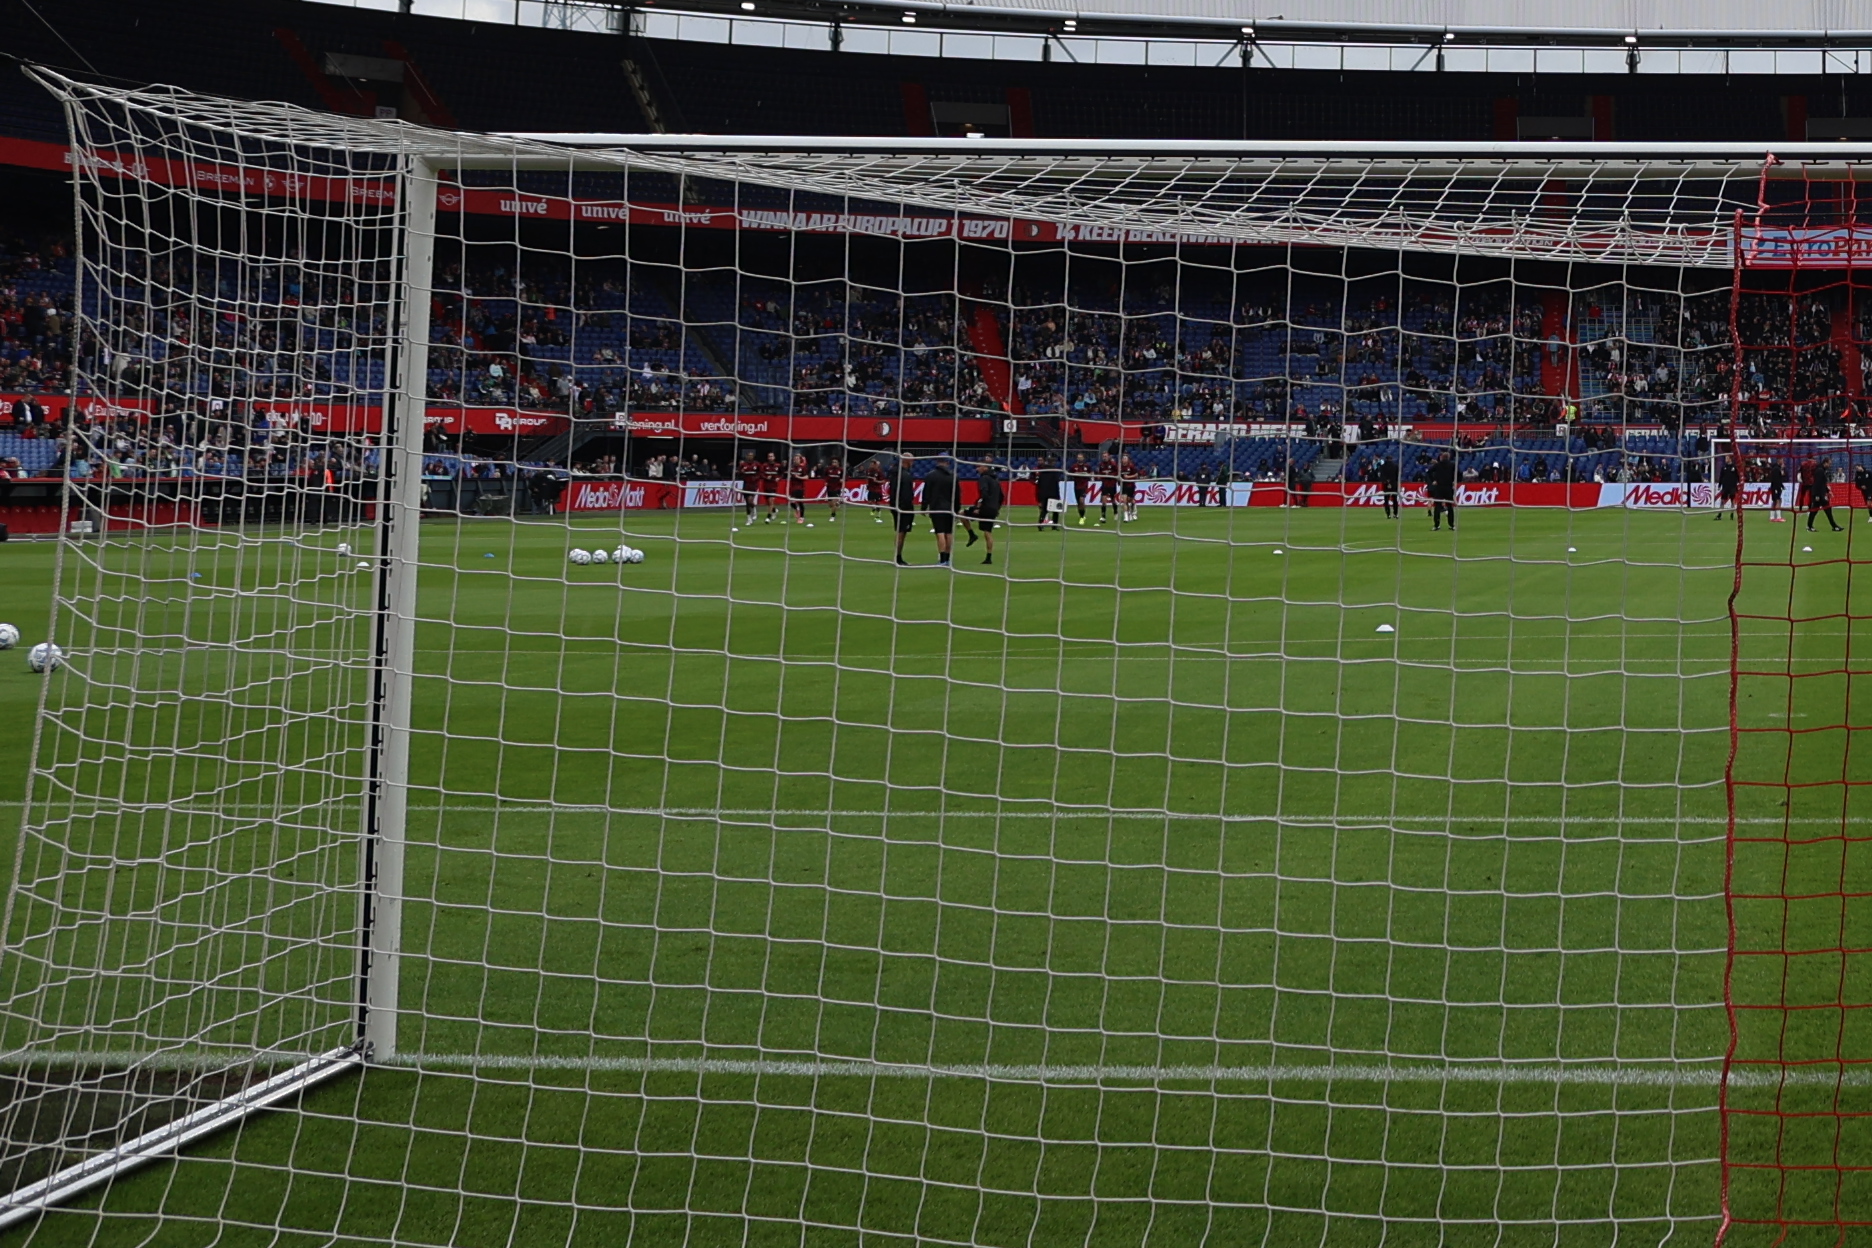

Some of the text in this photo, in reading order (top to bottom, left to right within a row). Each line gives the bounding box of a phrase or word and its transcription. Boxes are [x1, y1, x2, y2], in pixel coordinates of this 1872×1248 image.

[196, 170, 254, 186] BREEMAN
[352, 186, 397, 200] BREEM
[500, 199, 547, 215] univé
[581, 205, 628, 220] univé
[742, 210, 843, 232] WINNAAR
[840, 215, 947, 236] EUROPACUP
[962, 219, 1009, 238] 1970
[1056, 222, 1076, 241] 14
[701, 418, 768, 435] verloning.nl
